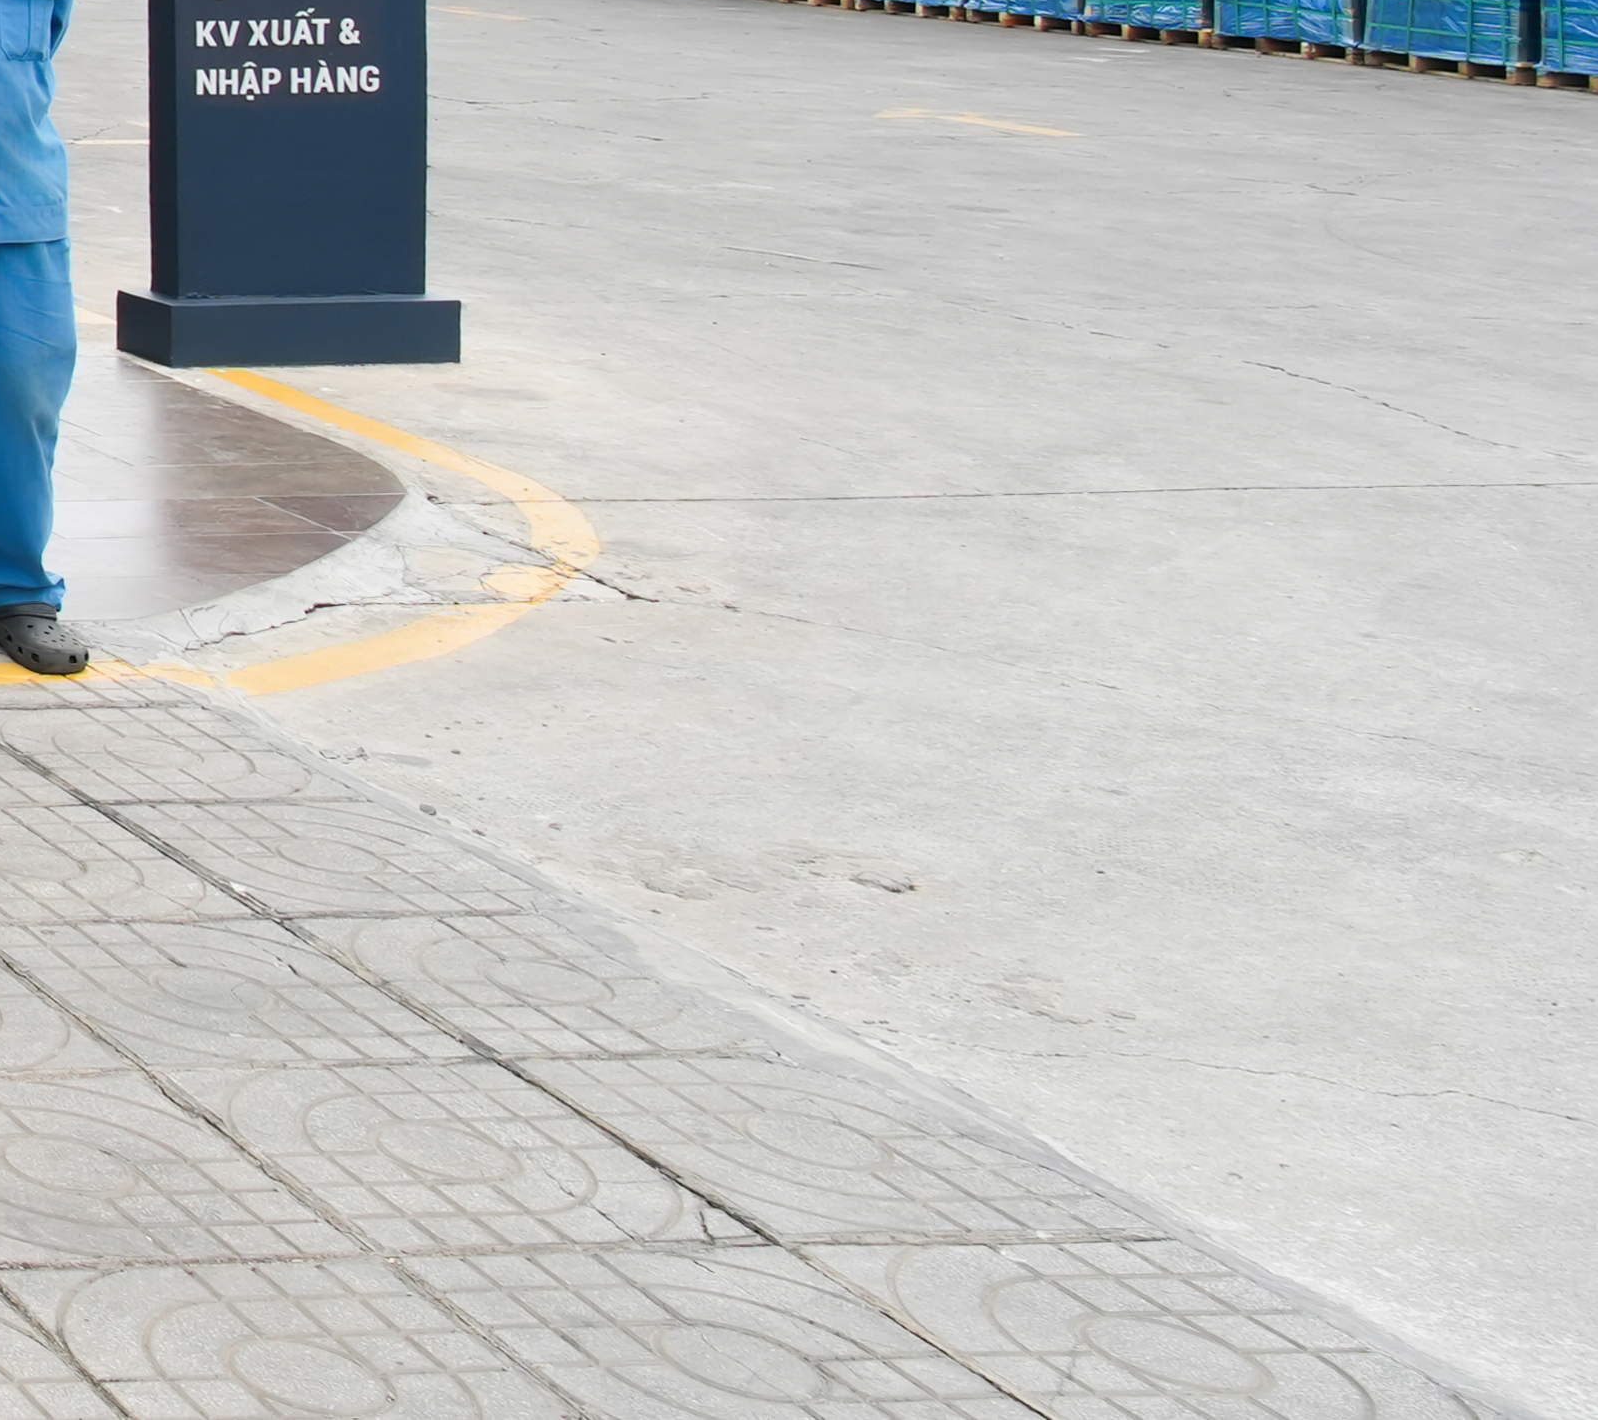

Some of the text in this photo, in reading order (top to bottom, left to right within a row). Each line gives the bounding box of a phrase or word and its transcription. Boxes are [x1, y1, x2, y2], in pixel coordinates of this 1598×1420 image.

[194, 7, 362, 48] KV XUẤT &
[194, 59, 382, 101] NHẬP HÀNG
